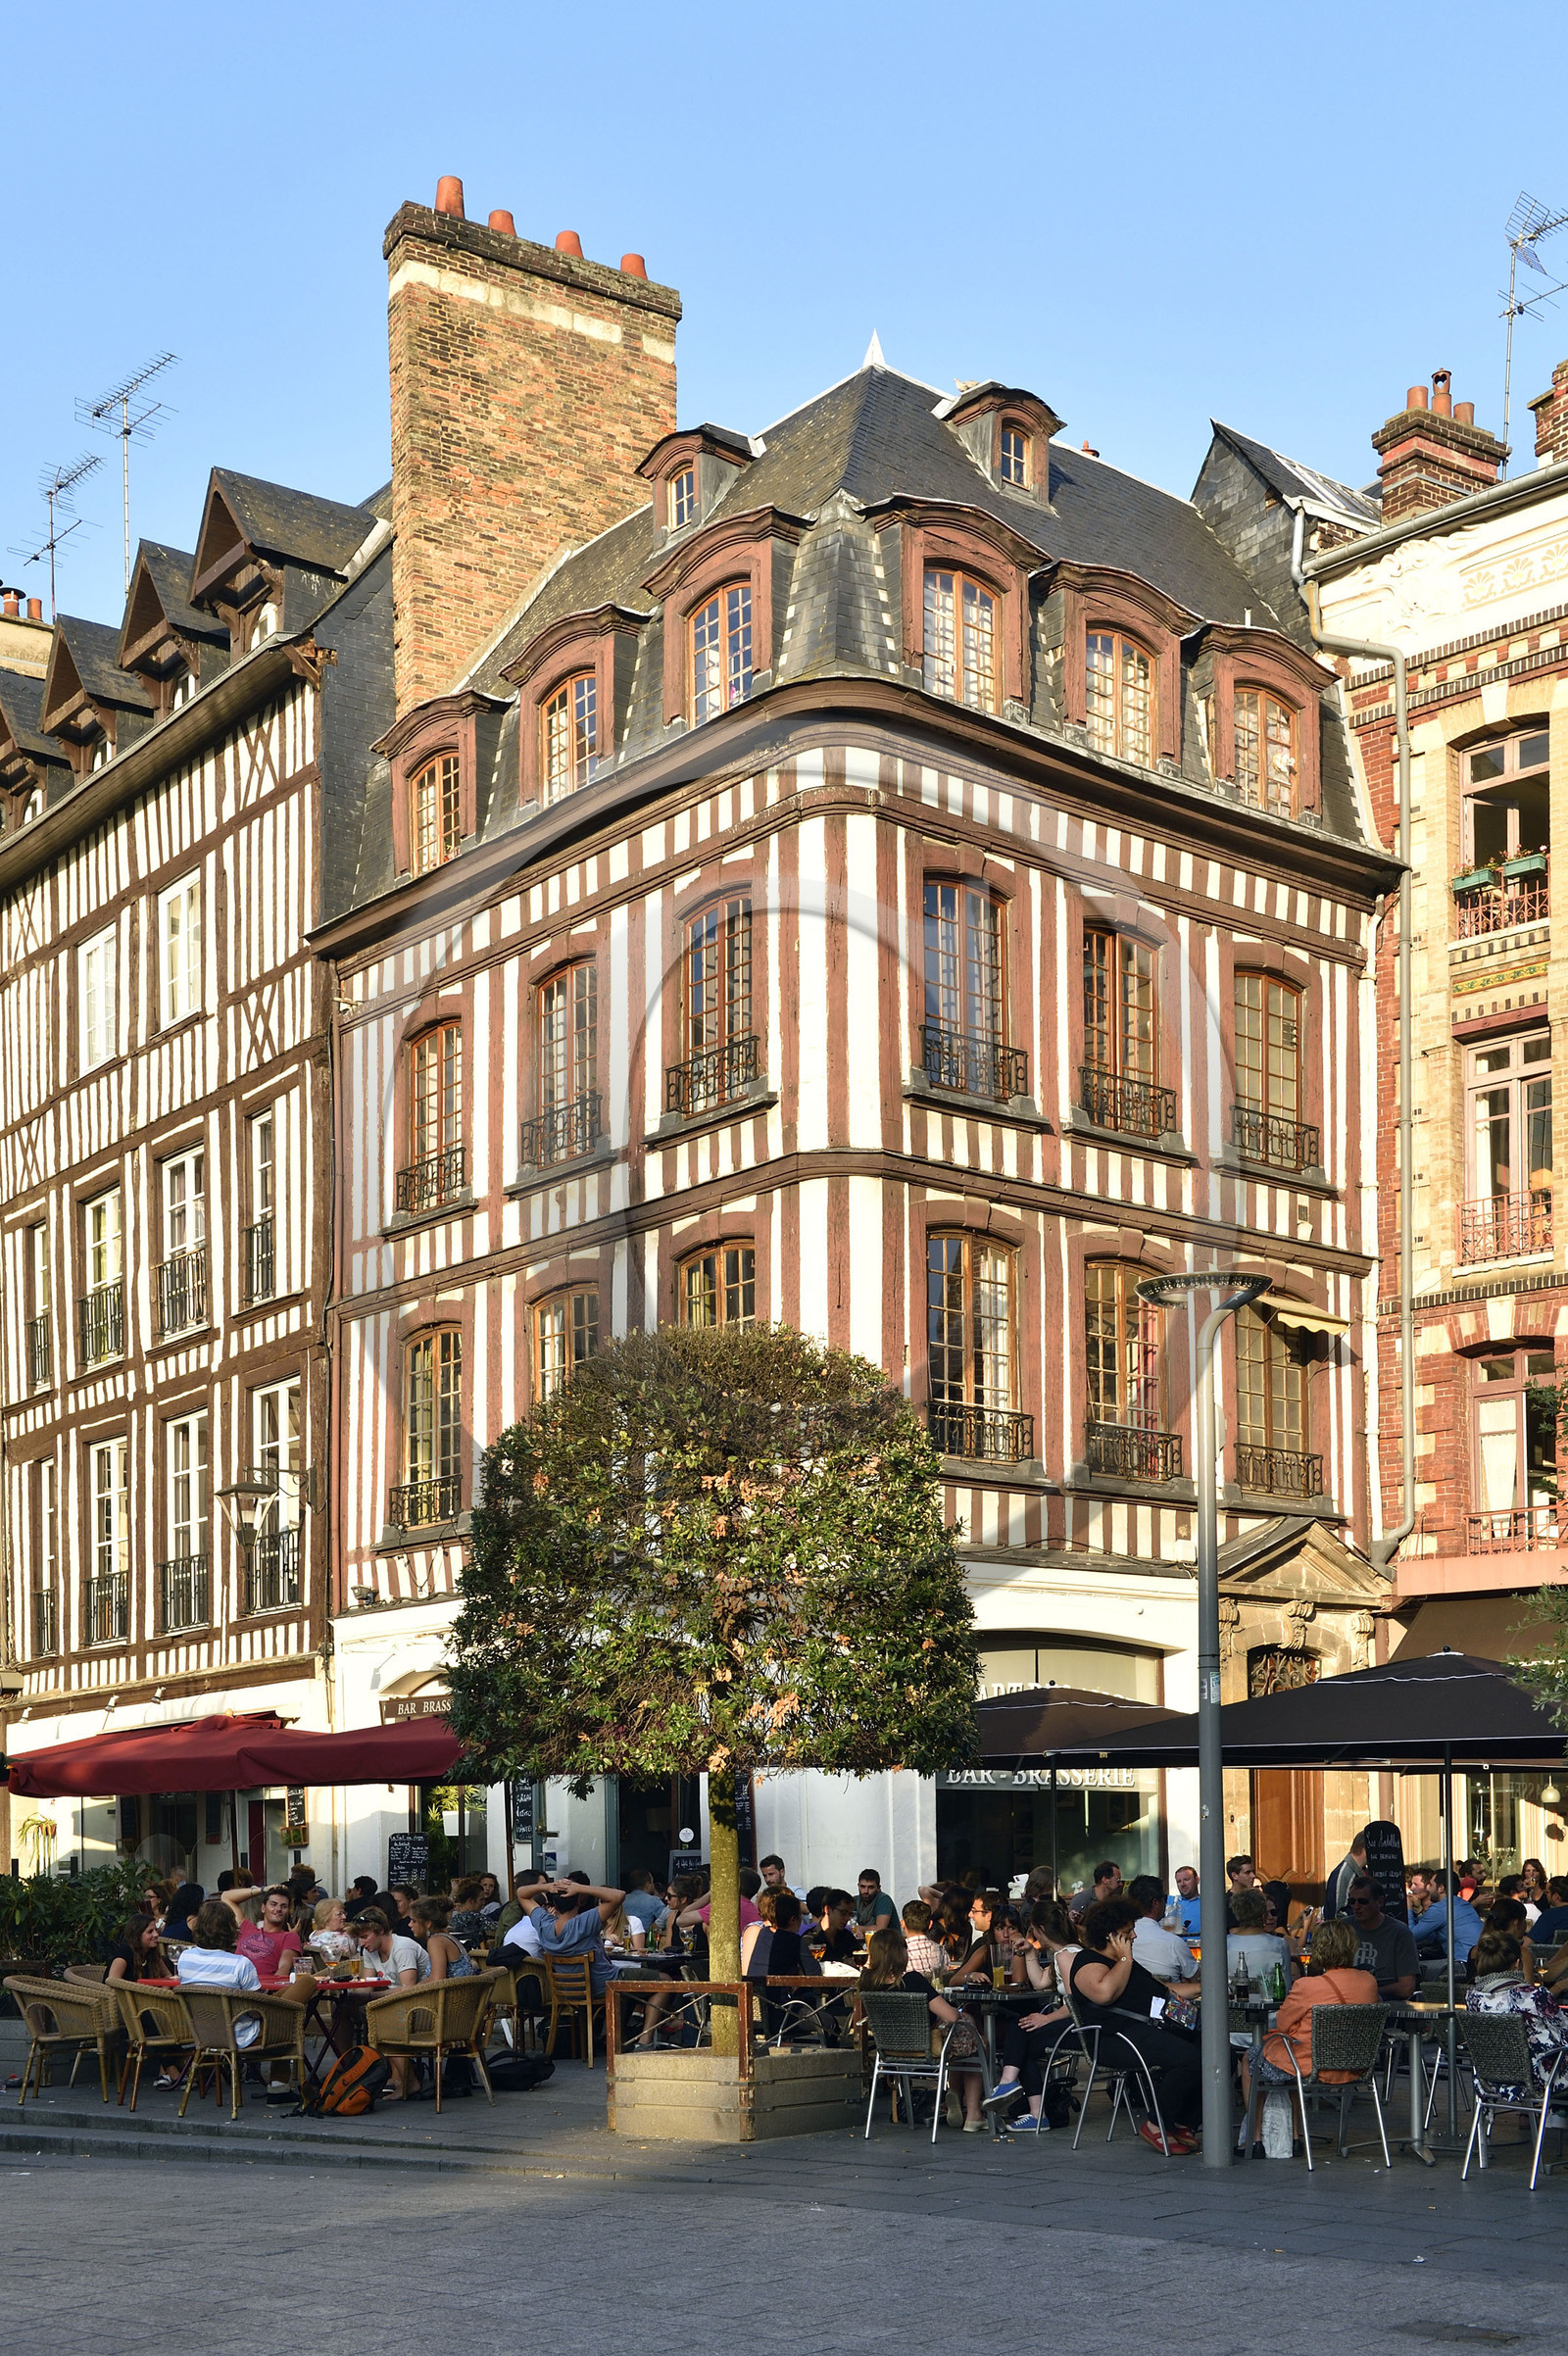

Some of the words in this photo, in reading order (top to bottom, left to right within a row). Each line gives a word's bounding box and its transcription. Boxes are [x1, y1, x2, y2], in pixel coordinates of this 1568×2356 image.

[398, 1702, 416, 1714] BAR
[946, 1769, 997, 1785] BAR
[1011, 1768, 1135, 1788] BRASSERIE
